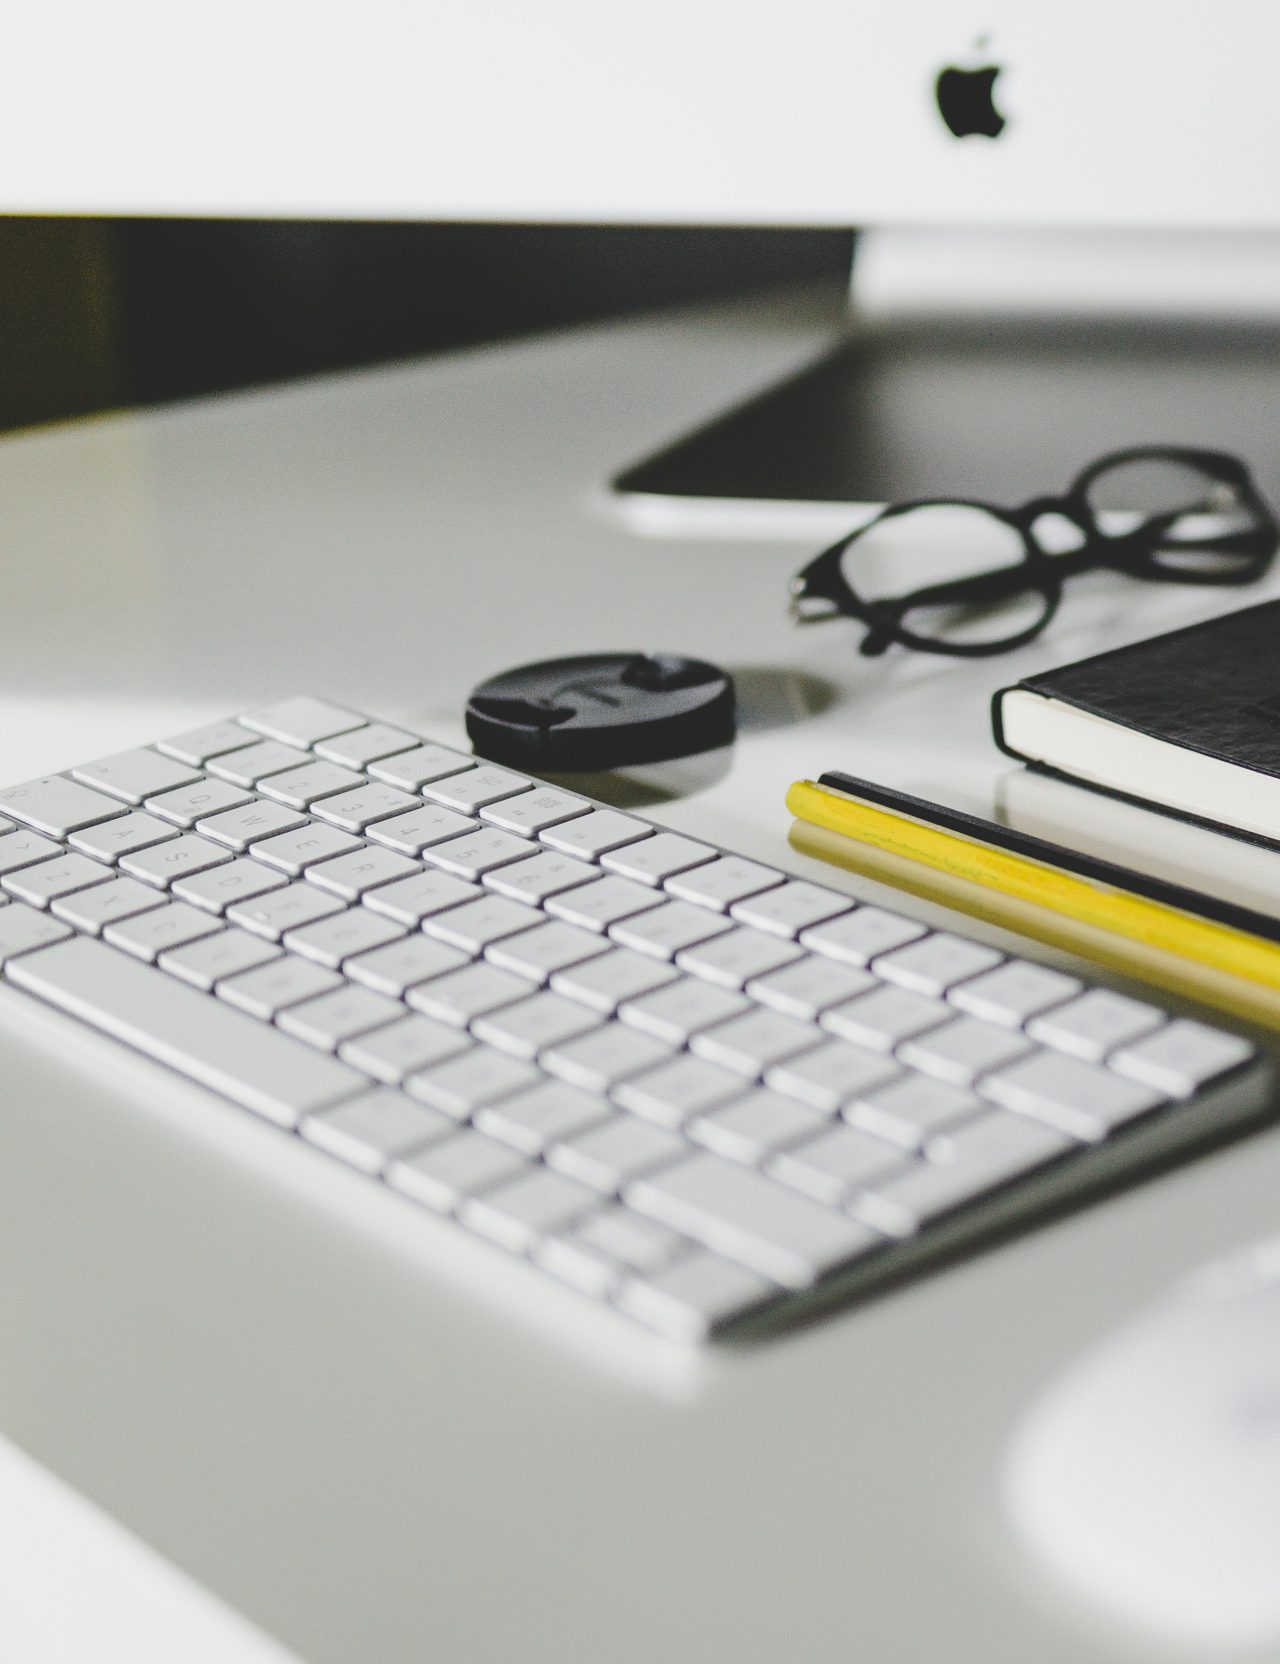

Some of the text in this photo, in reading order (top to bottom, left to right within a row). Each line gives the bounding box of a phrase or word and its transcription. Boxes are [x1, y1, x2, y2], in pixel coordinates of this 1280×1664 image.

[286, 781, 310, 791] 2
[188, 794, 212, 805] Q
[340, 803, 365, 813] 3
[239, 815, 268, 827] W
[111, 829, 135, 840] A
[399, 827, 421, 836] 4
[294, 839, 320, 850] E
[164, 852, 189, 862] S
[455, 849, 480, 860] 5
[352, 863, 376, 874] R
[45, 870, 72, 882] Z
[217, 876, 243, 887] D
